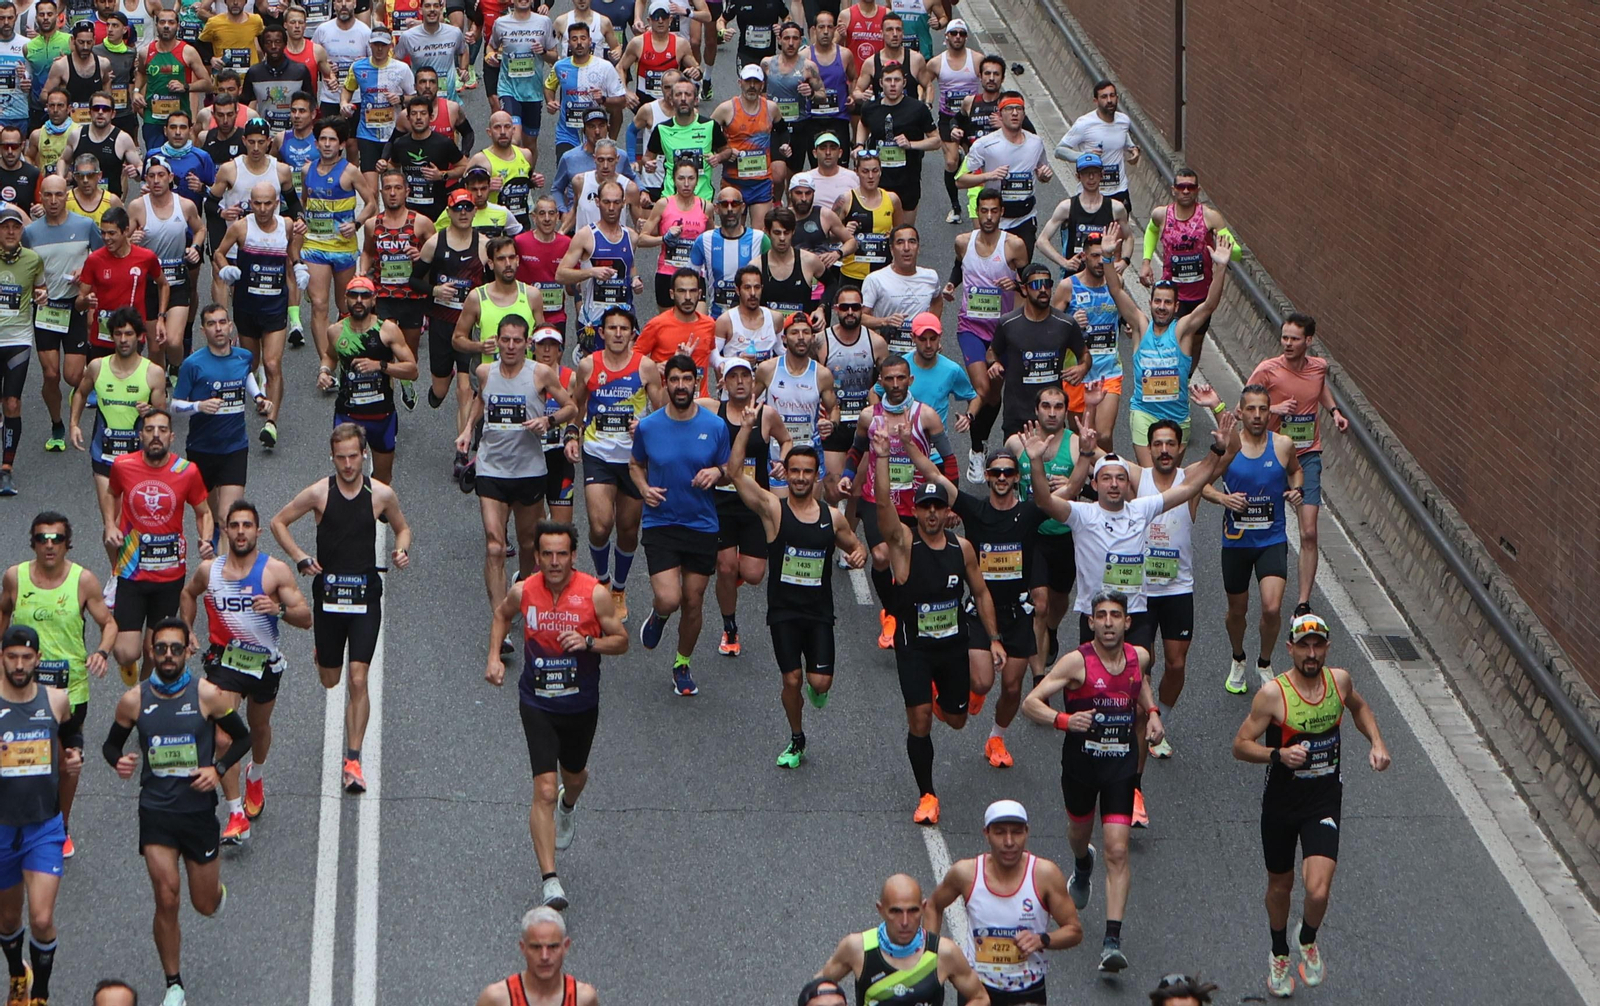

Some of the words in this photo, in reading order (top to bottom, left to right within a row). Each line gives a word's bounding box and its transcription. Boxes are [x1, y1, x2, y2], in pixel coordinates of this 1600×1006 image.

[376, 240, 410, 249] KENYA
[596, 389, 632, 398] PALACIEGO
[337, 588, 352, 596] 2541
[932, 601, 955, 611] ZURICH
[242, 644, 267, 653] ZURICH
[38, 673, 54, 681] 3022
[546, 672, 563, 680] 2970
[16, 731, 44, 740] ZURICH
[163, 736, 191, 744] ZURICH
[1313, 737, 1337, 748] ZURICH
[992, 928, 1019, 937] ZURICH
[992, 943, 1010, 952] 4272
